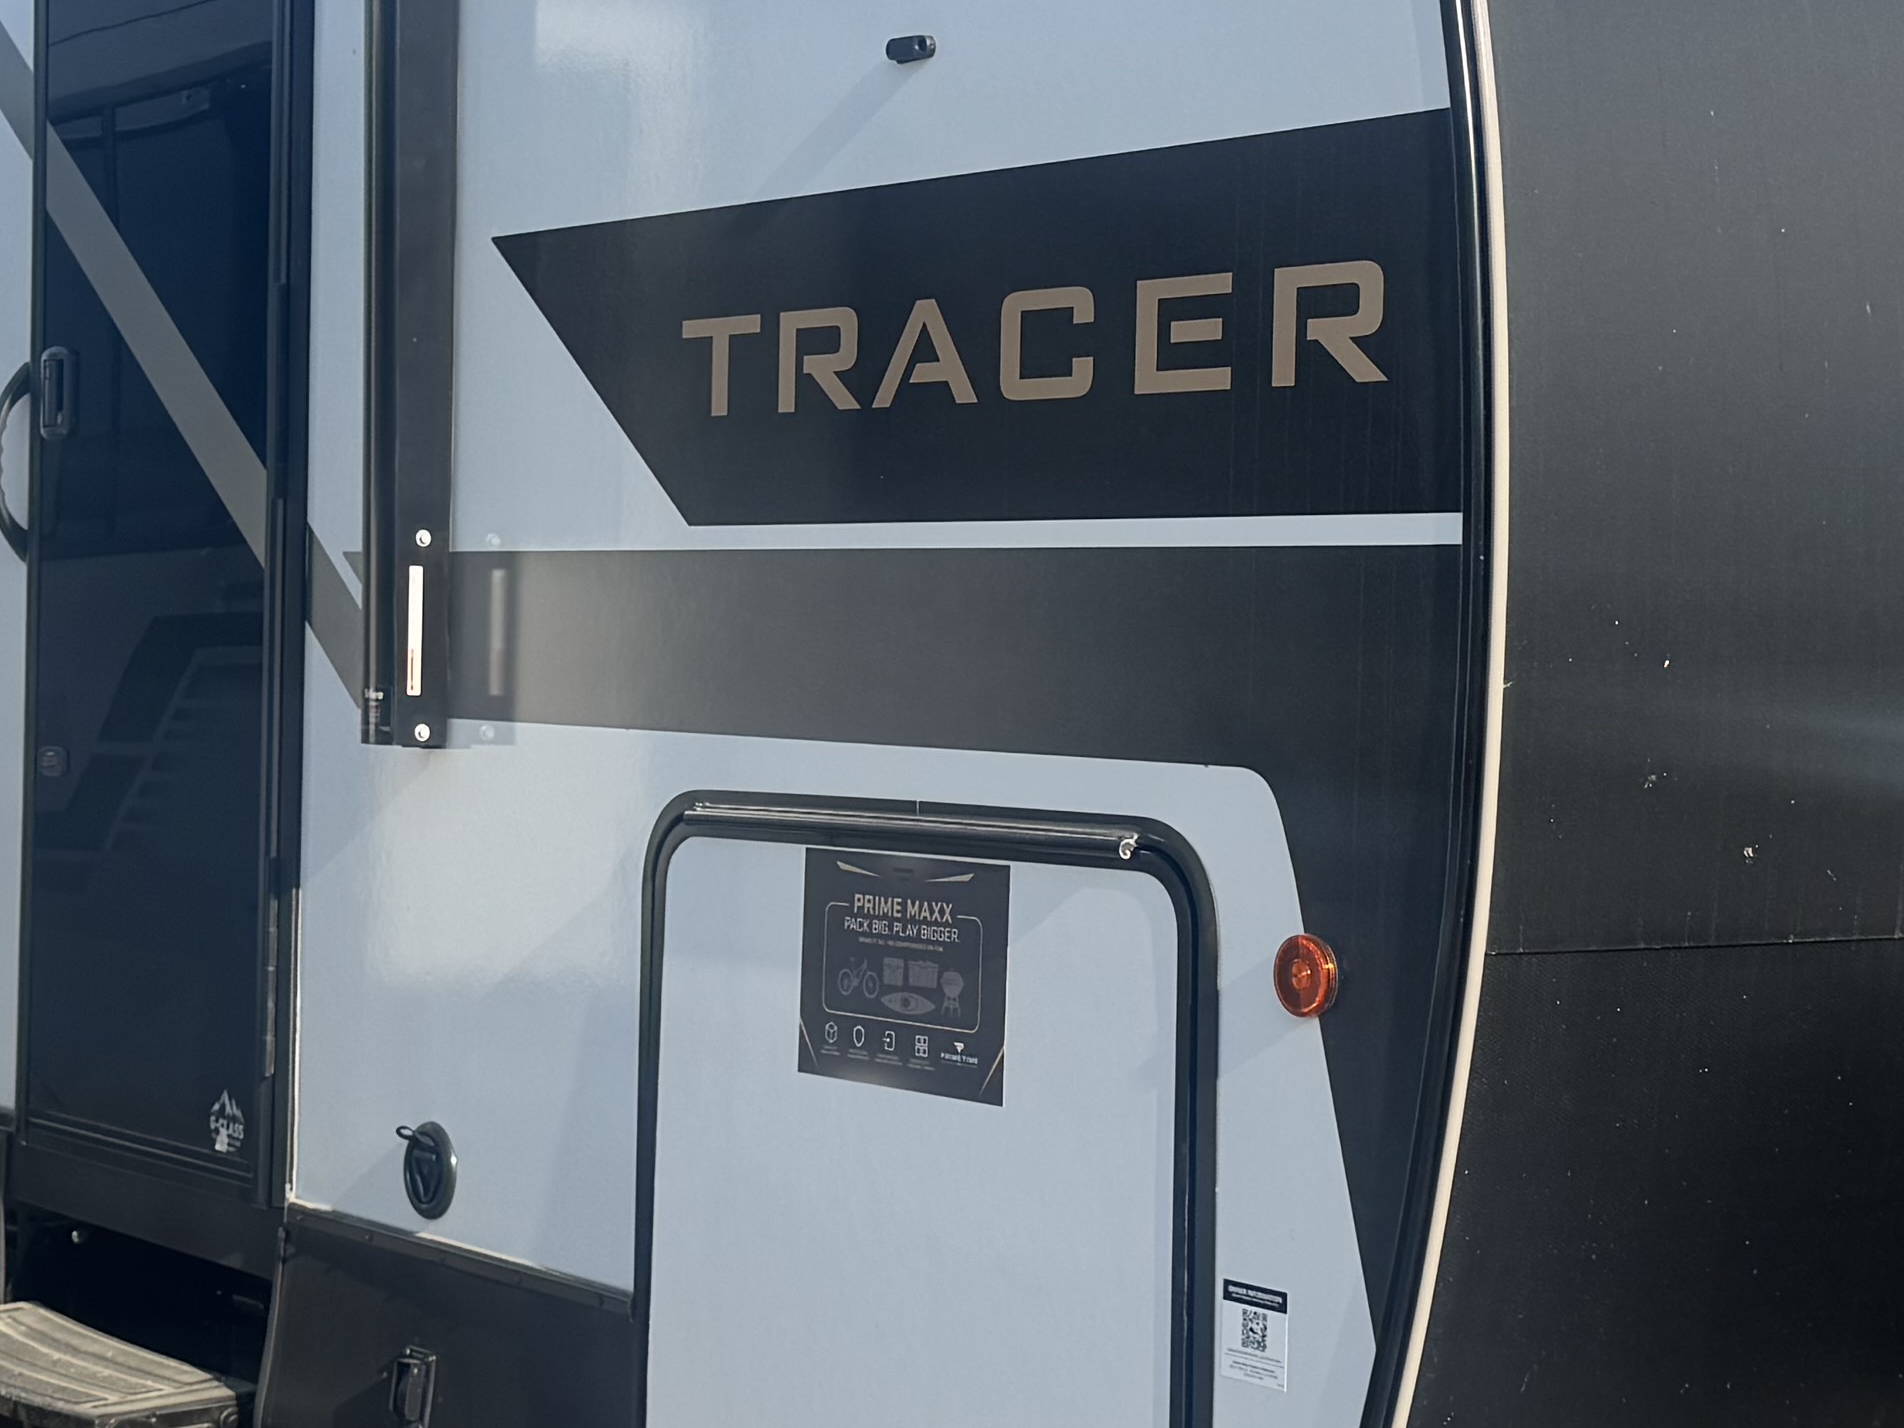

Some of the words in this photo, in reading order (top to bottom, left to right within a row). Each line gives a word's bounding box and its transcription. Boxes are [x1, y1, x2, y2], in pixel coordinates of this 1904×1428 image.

[681, 259, 1389, 418] TRACER
[853, 893, 903, 918] PRIME
[906, 899, 953, 924] MAXX
[844, 916, 870, 932] PACK
[893, 922, 918, 938] PLAY
